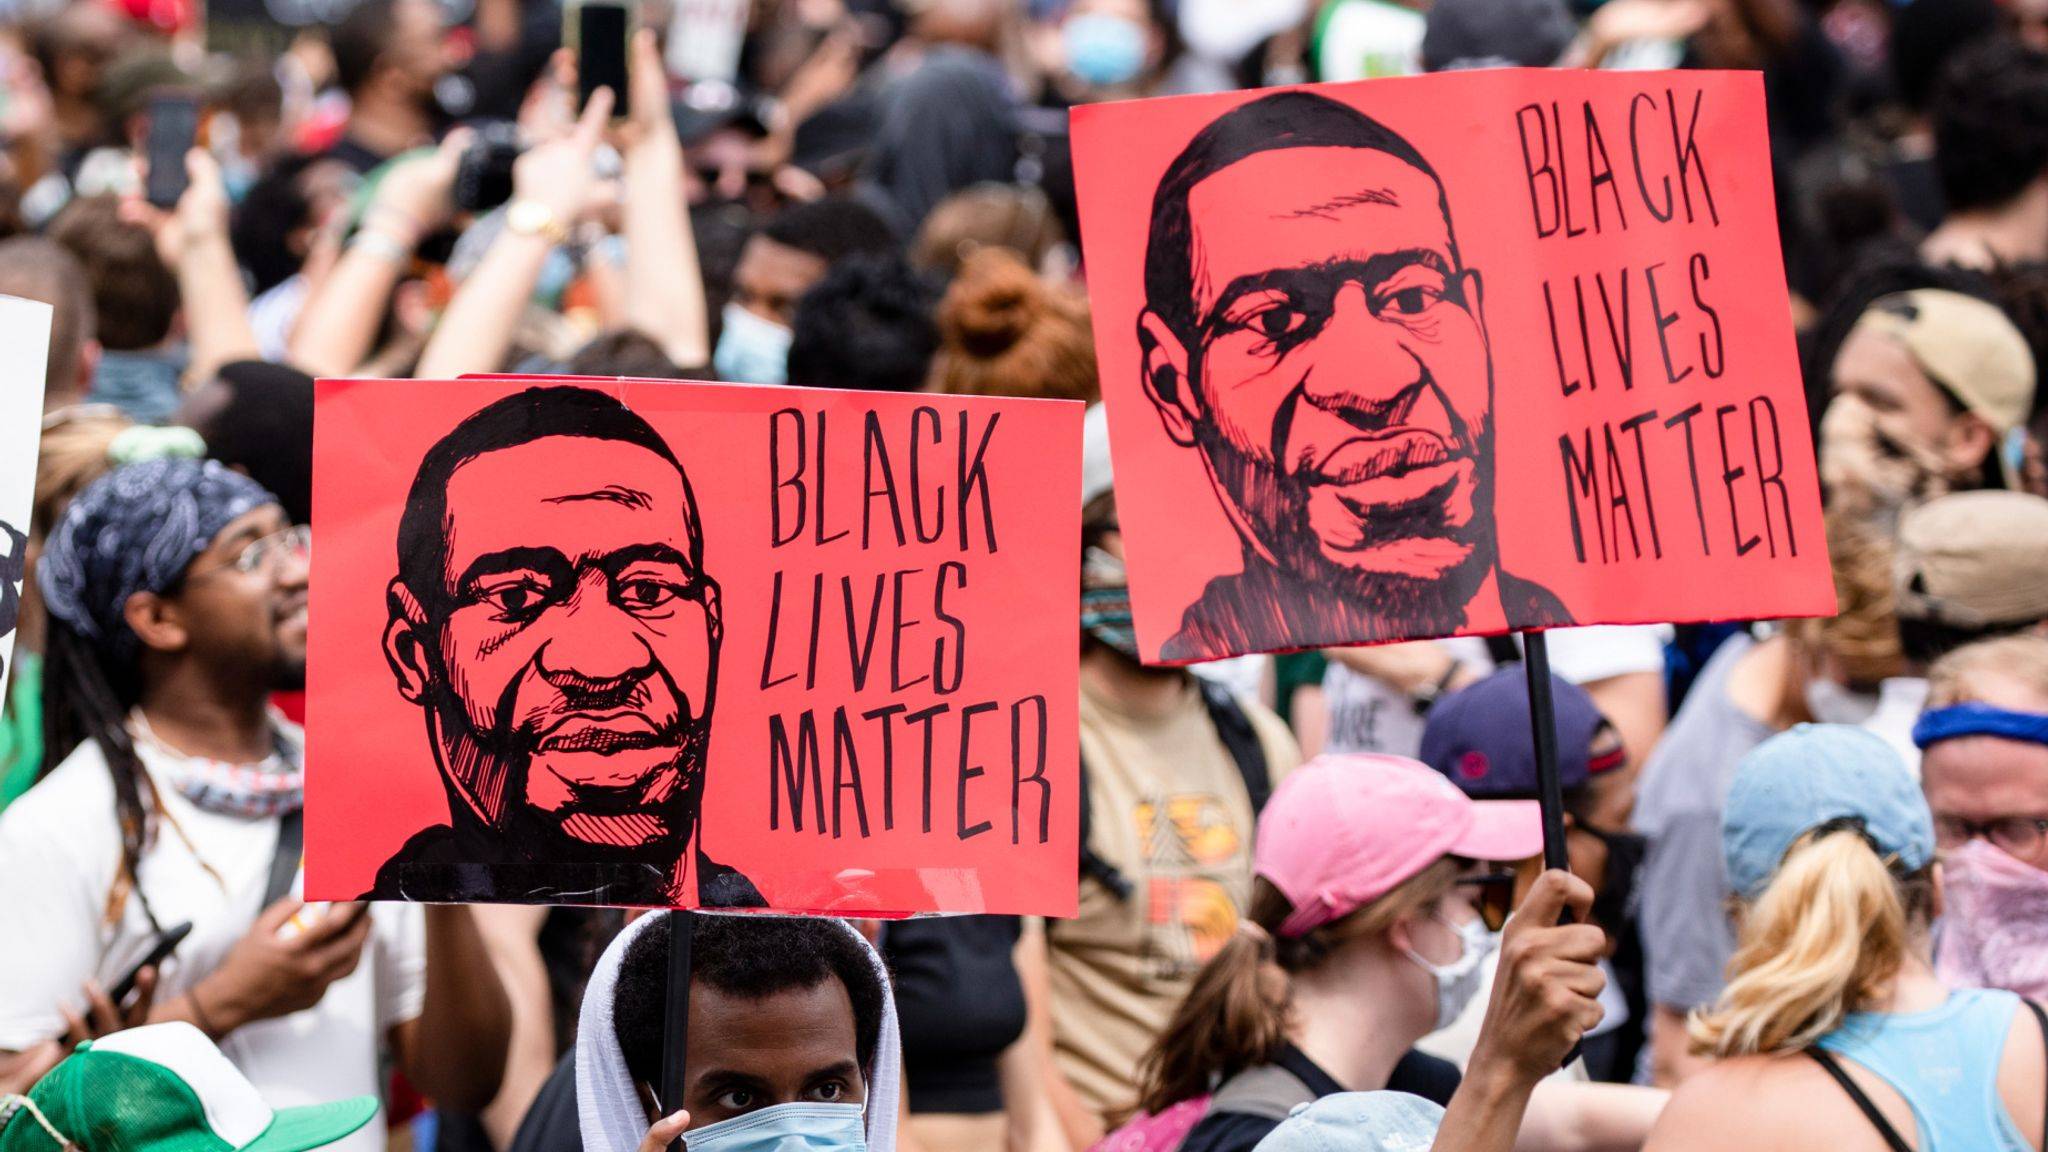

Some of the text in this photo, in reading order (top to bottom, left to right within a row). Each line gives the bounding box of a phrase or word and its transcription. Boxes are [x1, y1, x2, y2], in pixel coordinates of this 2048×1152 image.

[1515, 88, 1720, 239] BLACK
[1543, 253, 1724, 396] LIVES
[770, 406, 1000, 554] BLACK
[1558, 395, 1797, 564] MATTER
[760, 561, 967, 695] LIVES
[770, 695, 1051, 844] MATTER
